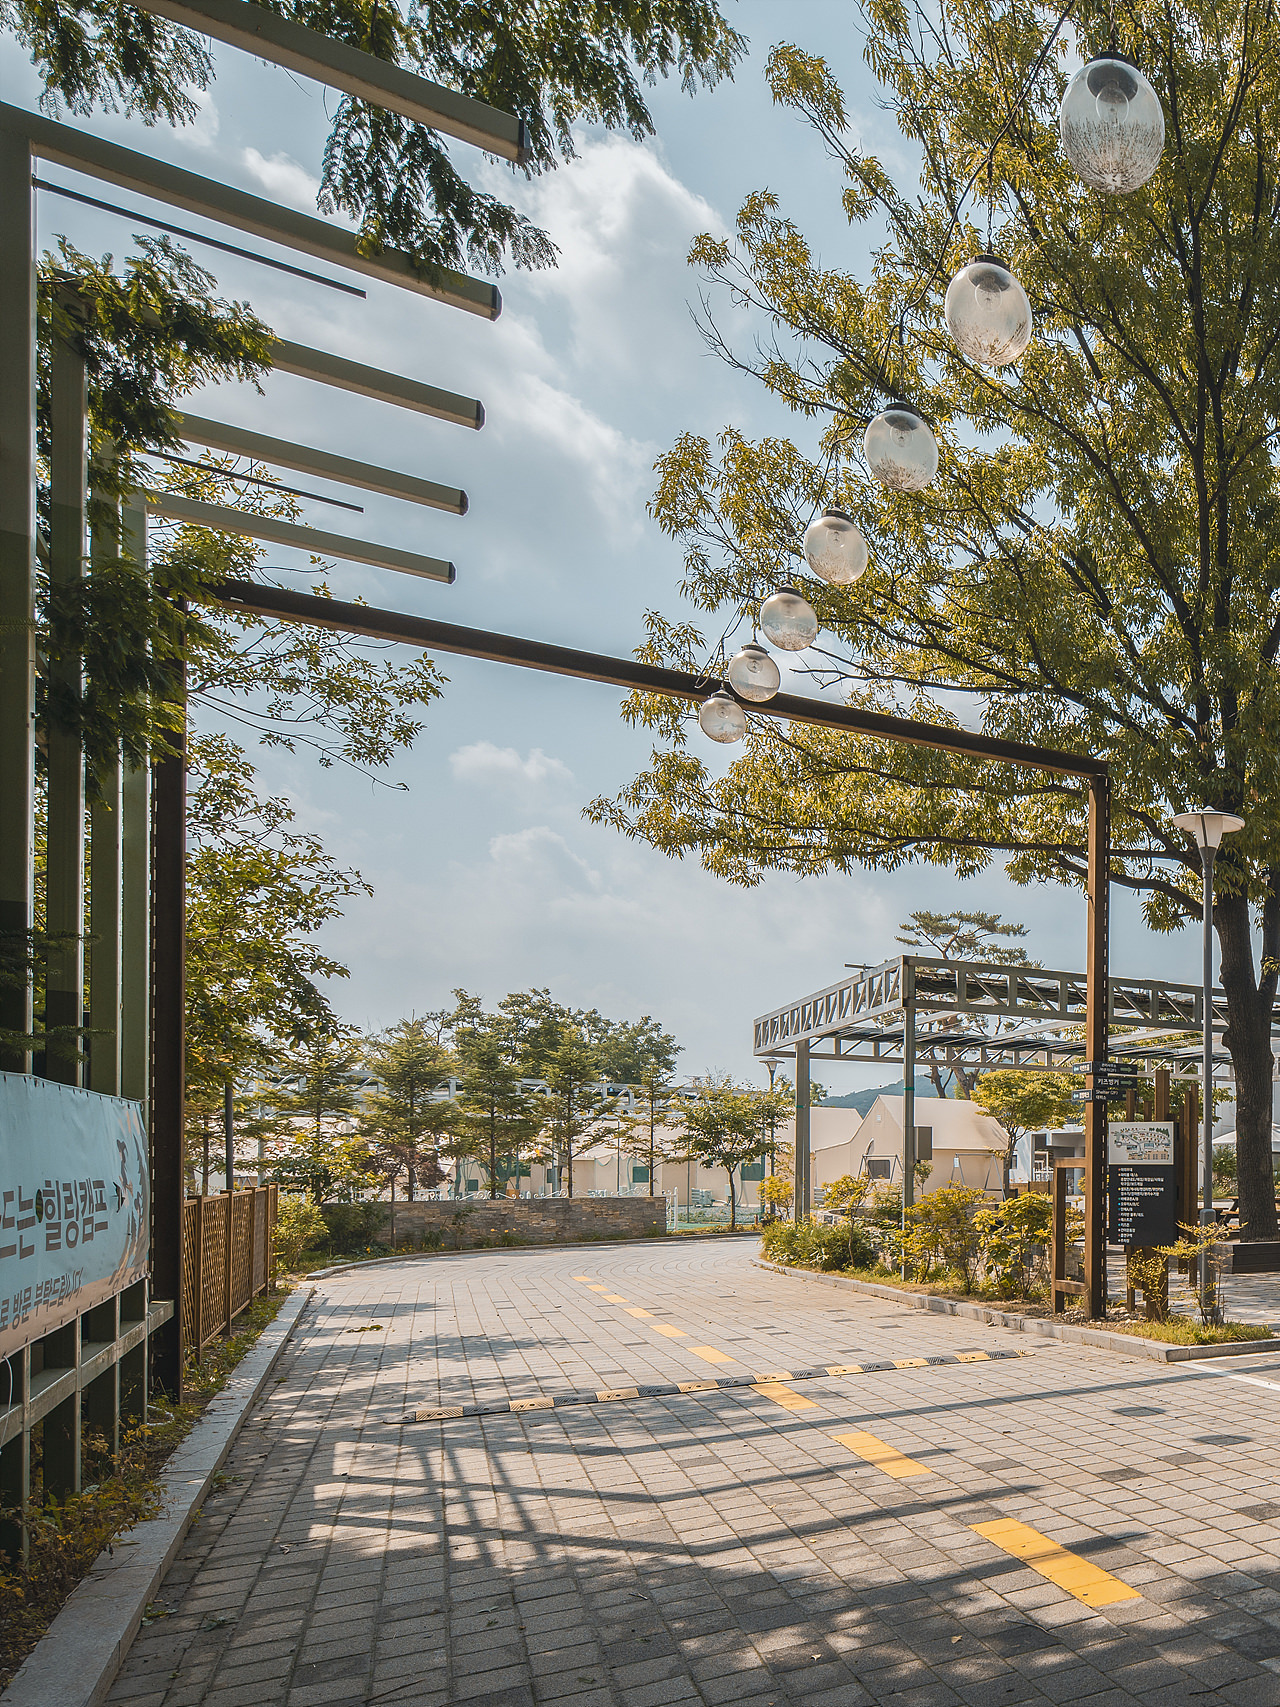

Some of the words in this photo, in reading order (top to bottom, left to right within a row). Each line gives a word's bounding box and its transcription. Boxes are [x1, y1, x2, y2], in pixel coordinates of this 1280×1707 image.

[1097, 1078, 1120, 1086] 키즈벙커
[42, 1177, 109, 1252] 힐링캠프
[12, 1286, 32, 1330] 방문
